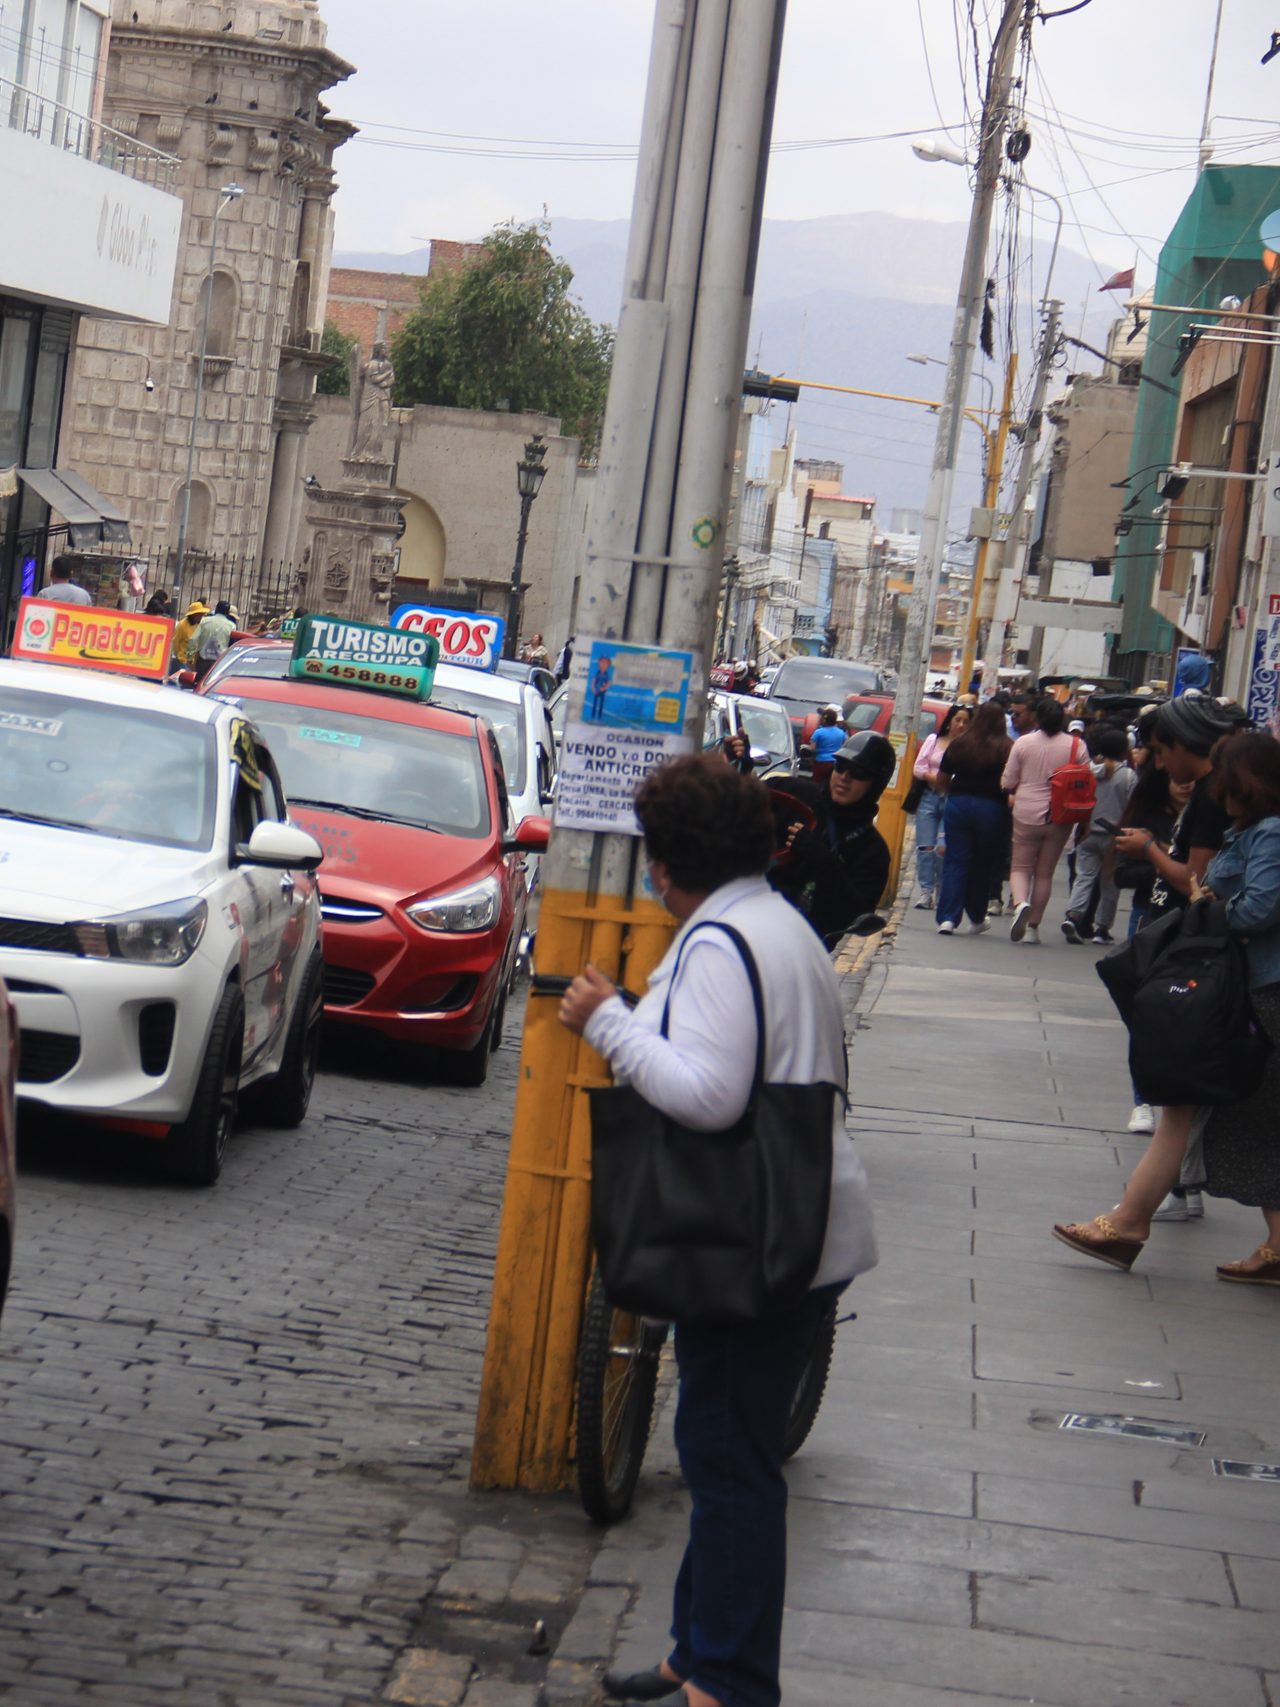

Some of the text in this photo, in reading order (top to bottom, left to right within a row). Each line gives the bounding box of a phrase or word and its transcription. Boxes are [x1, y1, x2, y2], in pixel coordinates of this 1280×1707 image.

[50, 613, 165, 659] Panatour
[311, 620, 427, 656] TURISMO
[305, 649, 423, 666] AREQUIPA
[326, 664, 418, 690] 458888
[606, 733, 664, 747] OCASION
[566, 742, 617, 759] VENDO
[584, 760, 657, 777] ANTICRE
[599, 800, 633, 811] CERCAD
